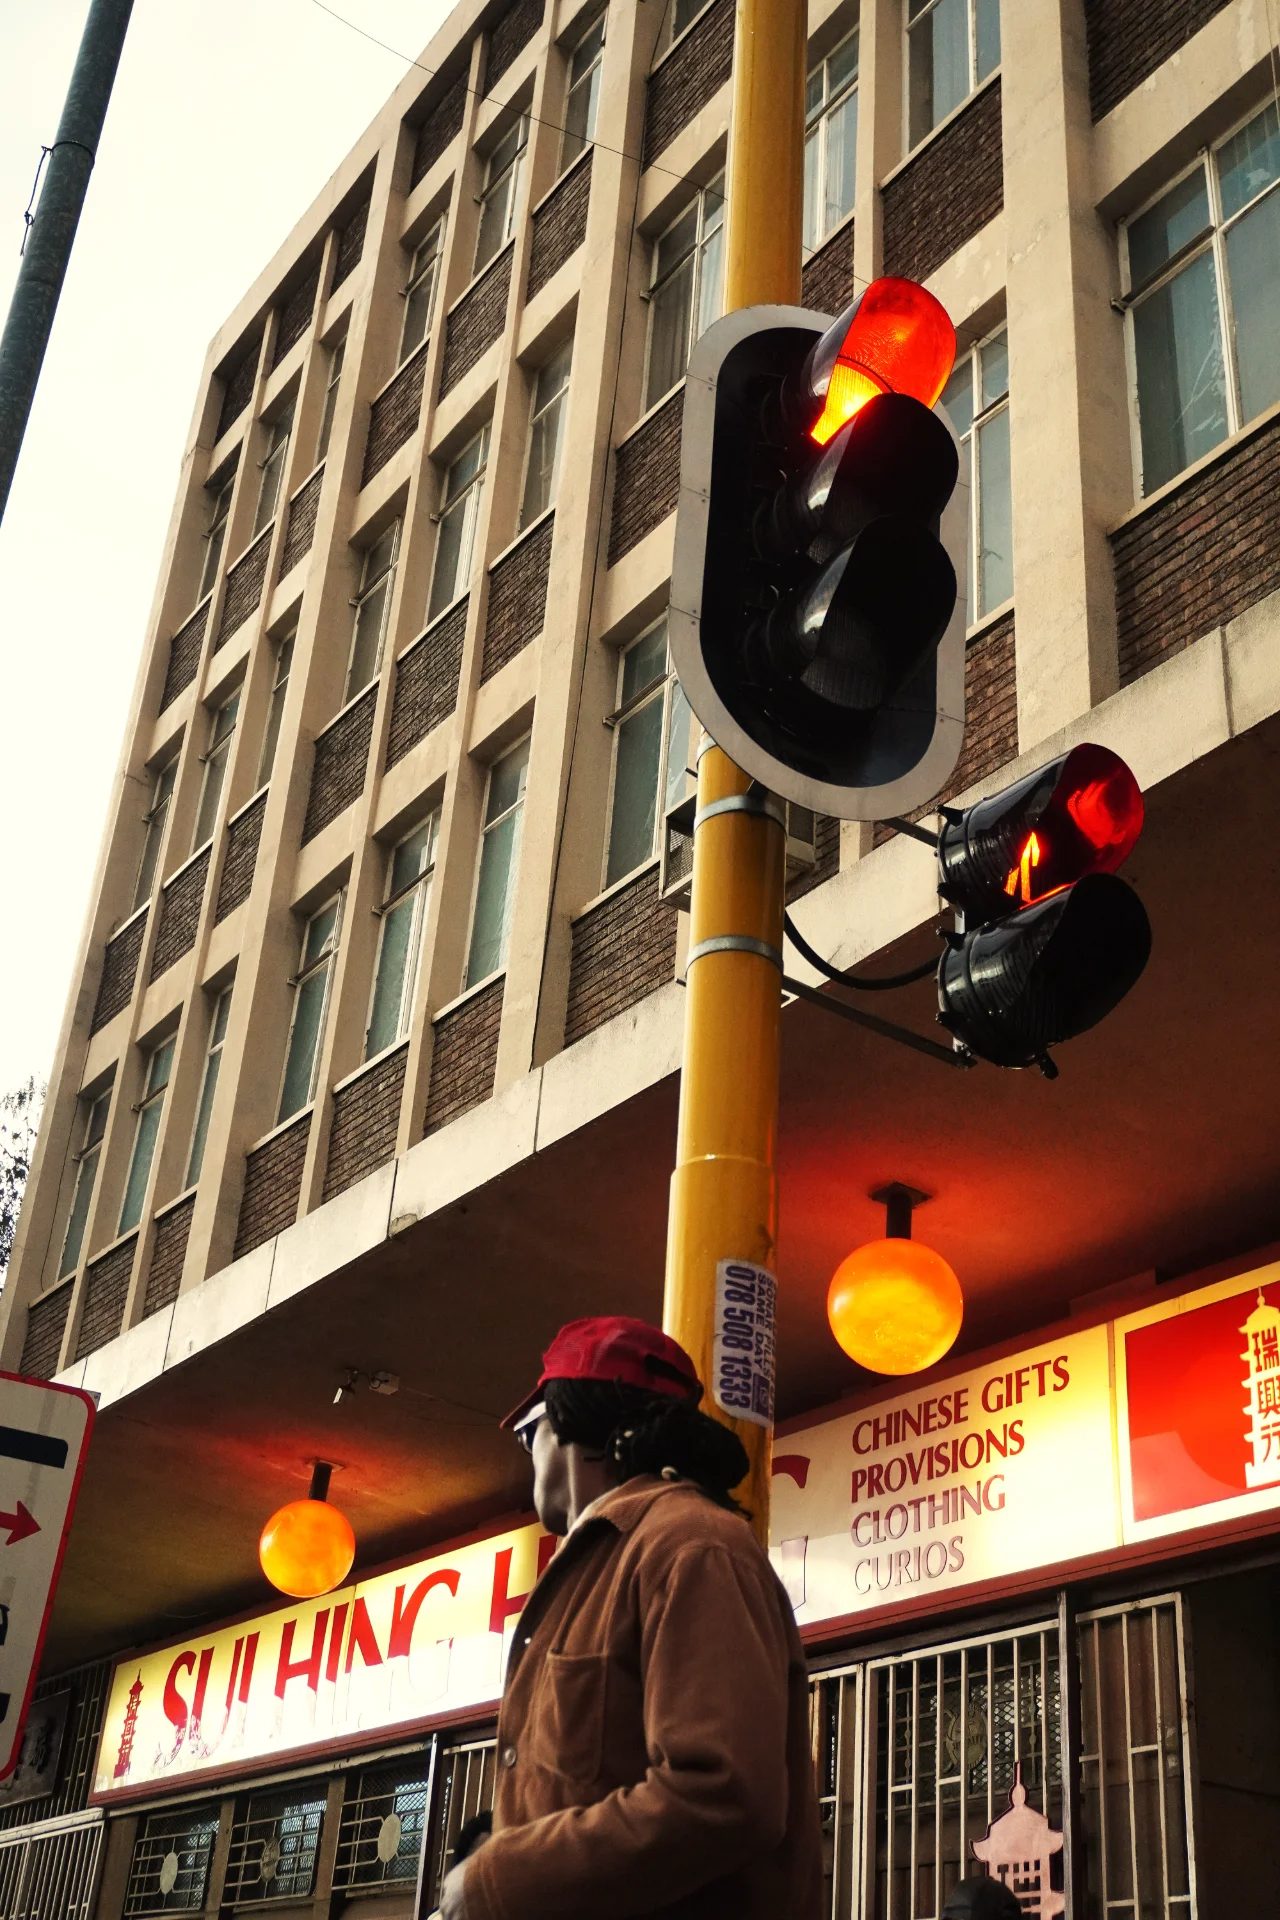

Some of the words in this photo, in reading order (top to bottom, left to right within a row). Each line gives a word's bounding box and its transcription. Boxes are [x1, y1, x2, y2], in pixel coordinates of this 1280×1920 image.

[725, 1265, 756, 1305] 078
[757, 1272, 766, 1327] SAME
[722, 1307, 755, 1351] 508
[754, 1331, 764, 1370] DAY
[719, 1356, 752, 1408] 1333
[852, 1388, 969, 1455] CHINESE
[981, 1355, 1070, 1413] GIFTS
[851, 1419, 1025, 1504] PROVISIONS
[851, 1474, 1006, 1548] CLOTHING
[854, 1535, 965, 1595] CURIOS
[153, 1631, 260, 1767] SUI
[268, 1568, 462, 1735] HING
